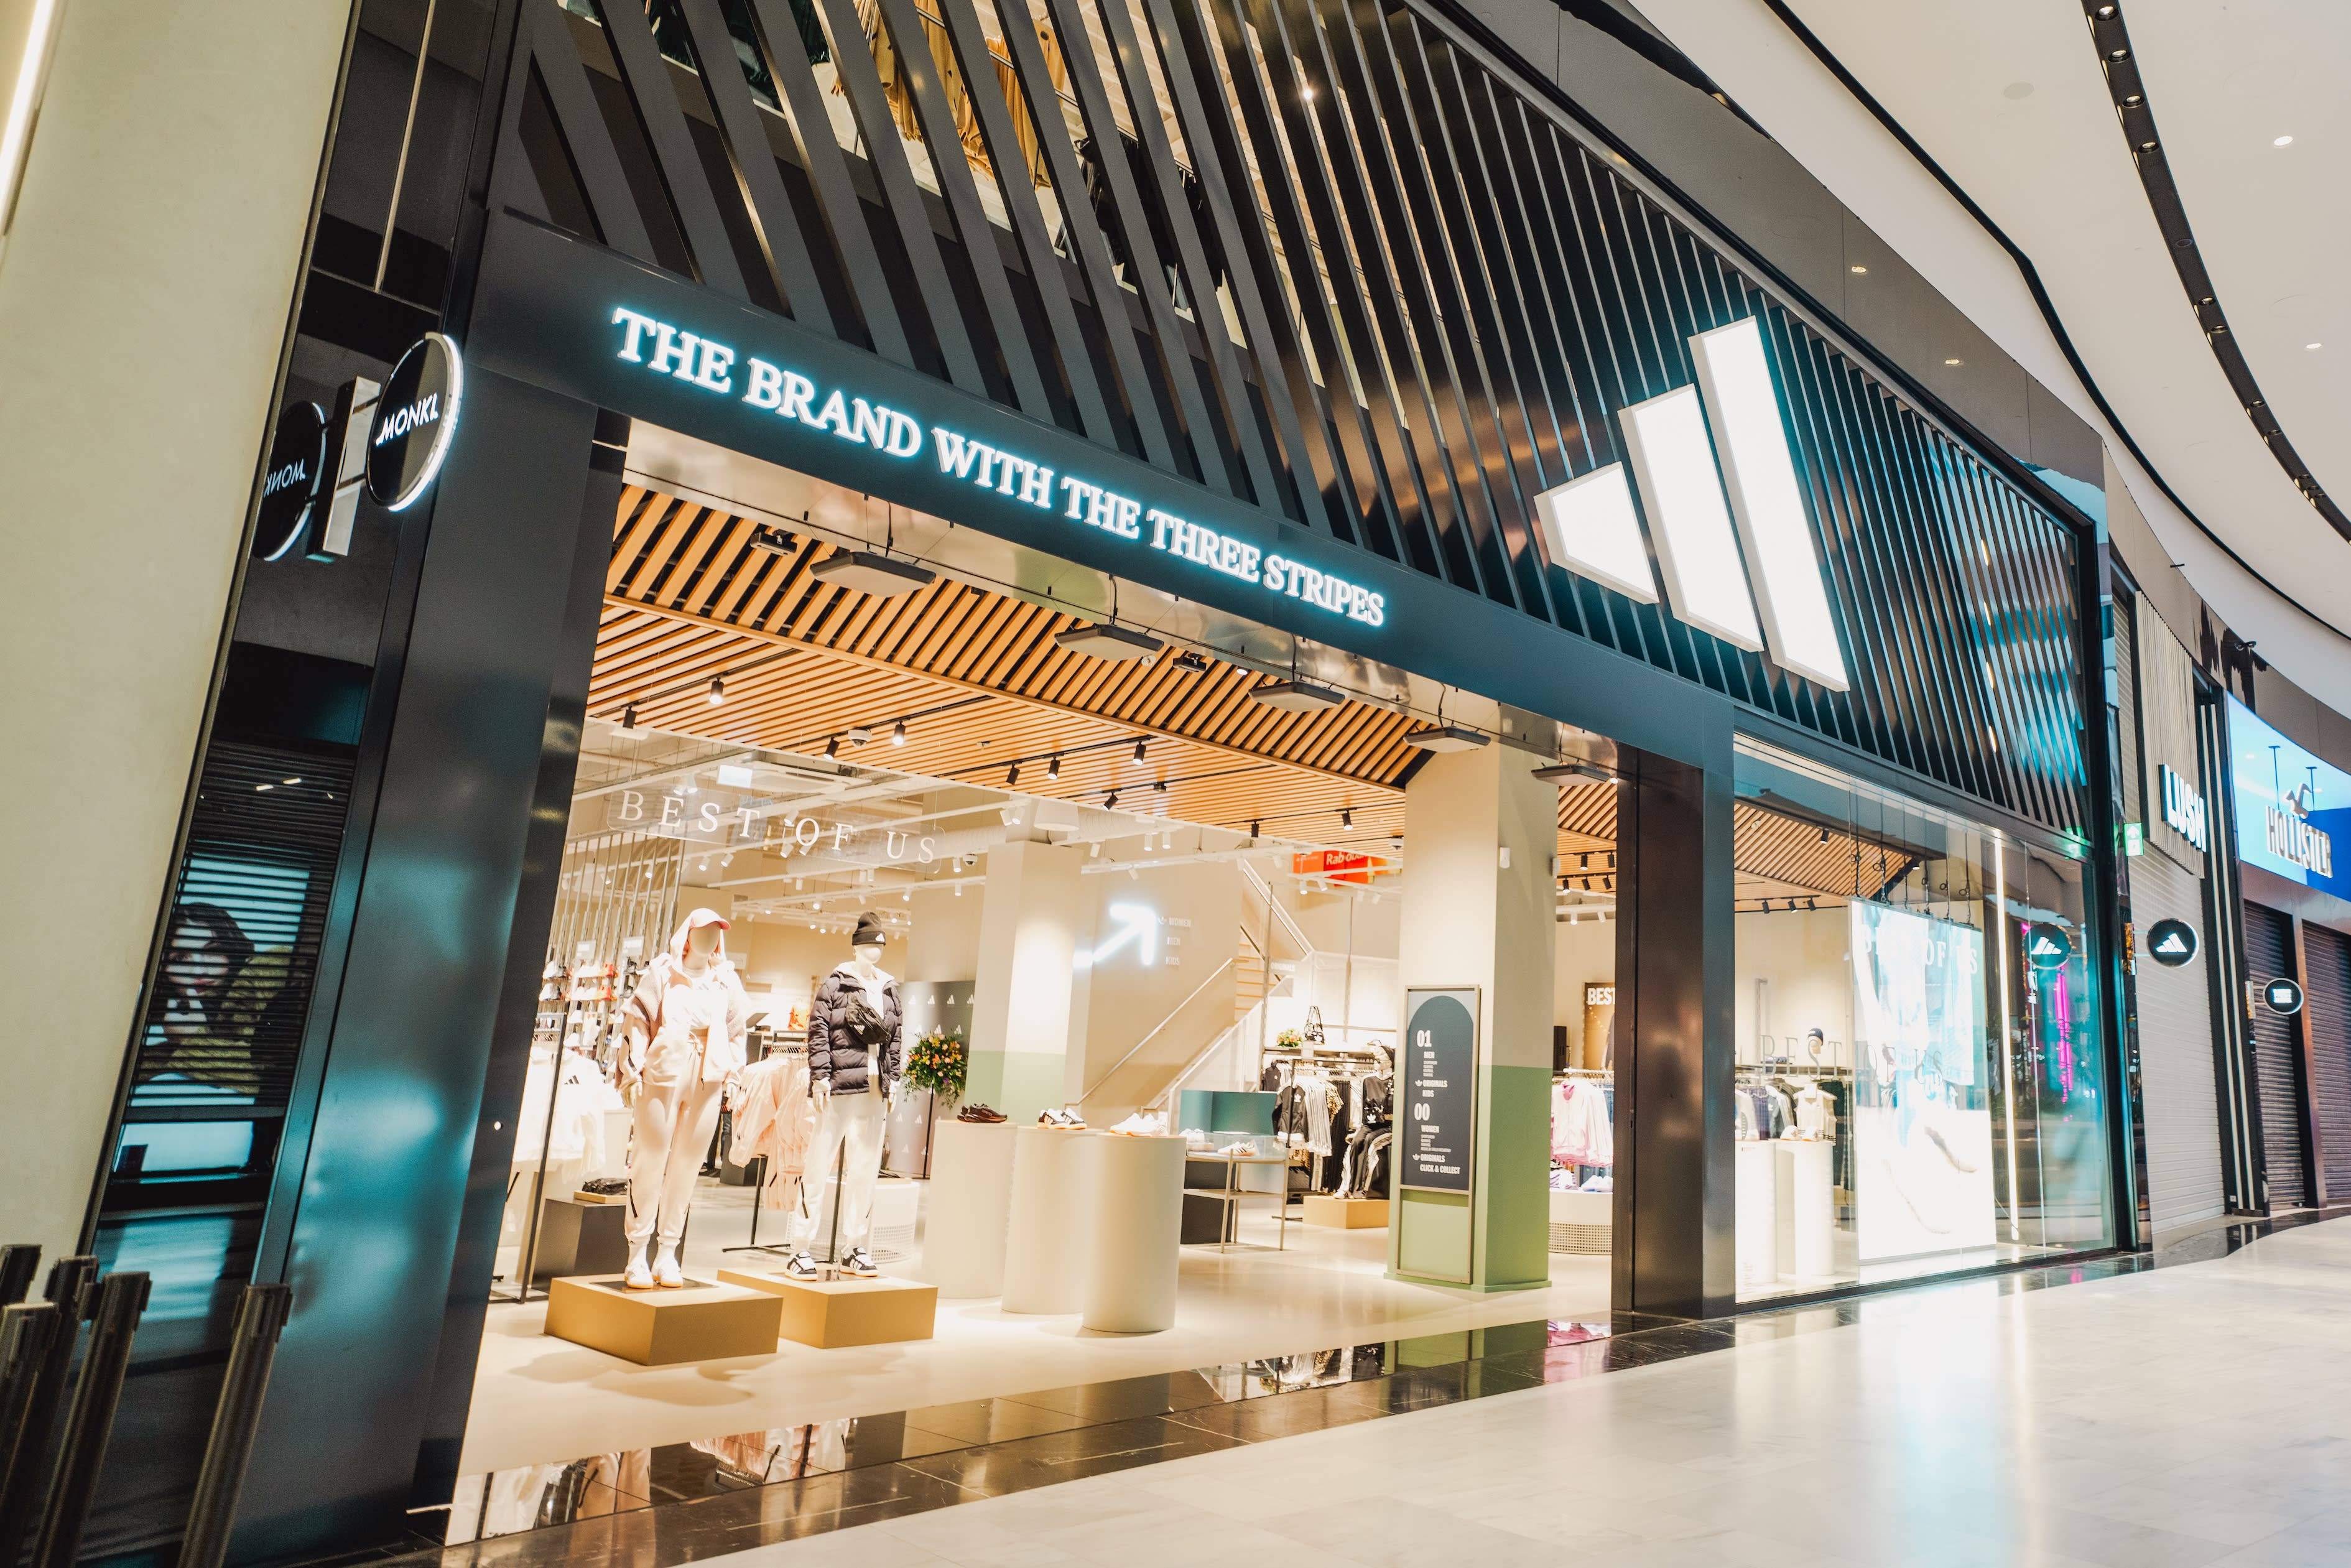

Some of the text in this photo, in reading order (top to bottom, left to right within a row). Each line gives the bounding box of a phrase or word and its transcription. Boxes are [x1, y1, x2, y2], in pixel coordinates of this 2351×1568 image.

[612, 307, 1384, 627] THE BRAND WITH THE THREE STRIPES
[2163, 763, 2207, 853] LUSH
[616, 789, 937, 865] BEST OF US
[2266, 805, 2333, 878] HOLLISTER
[1166, 956, 1180, 965] KIDS
[1416, 1029, 1432, 1047] 01
[1761, 1034, 1842, 1080] BEST
[1422, 1079, 1448, 1088] ORIGINALS
[1422, 1089, 1434, 1097] KIDS
[1414, 1103, 1431, 1121] 00
[1421, 1125, 1440, 1133] WOMEN
[1420, 1153, 1445, 1162] ORIGINALS
[1419, 1164, 1460, 1175] CLICK & COLLECT
